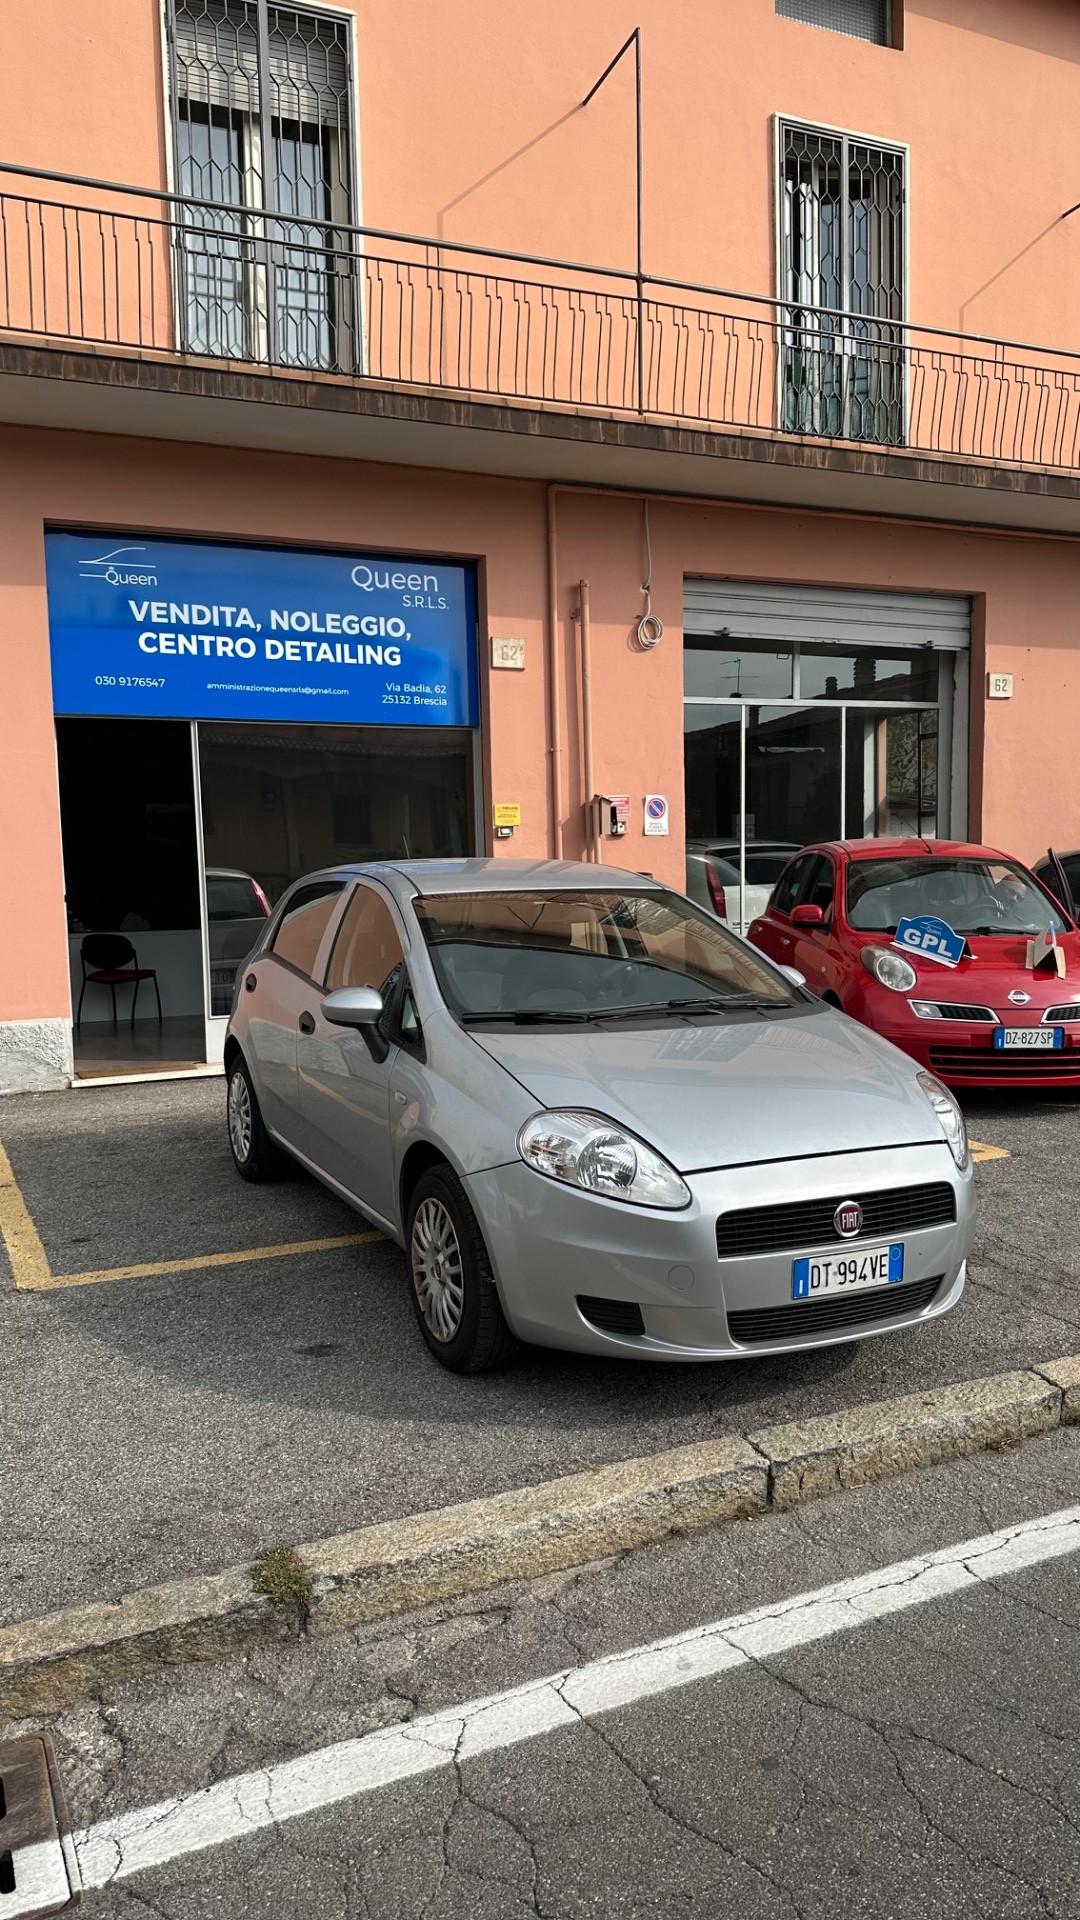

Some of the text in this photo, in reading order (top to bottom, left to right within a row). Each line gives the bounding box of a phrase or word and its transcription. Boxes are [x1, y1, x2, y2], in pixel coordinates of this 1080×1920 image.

[105, 567, 157, 587] Queen
[350, 565, 439, 593] Queen
[402, 594, 449, 610] S.R.L.S.
[128, 600, 412, 641] VENDITA, NOLEGGIO,
[138, 632, 402, 667] CENTRO DETAILING
[95, 675, 165, 688] 030 9176547
[206, 681, 349, 696] amministrazionequeensrls@gmail.com
[385, 682, 447, 695] Via Badia, 62
[995, 678, 1008, 692] 62
[382, 695, 447, 706] 25132 Brescia
[903, 928, 953, 958] GPL
[841, 1212, 858, 1229] FIAT
